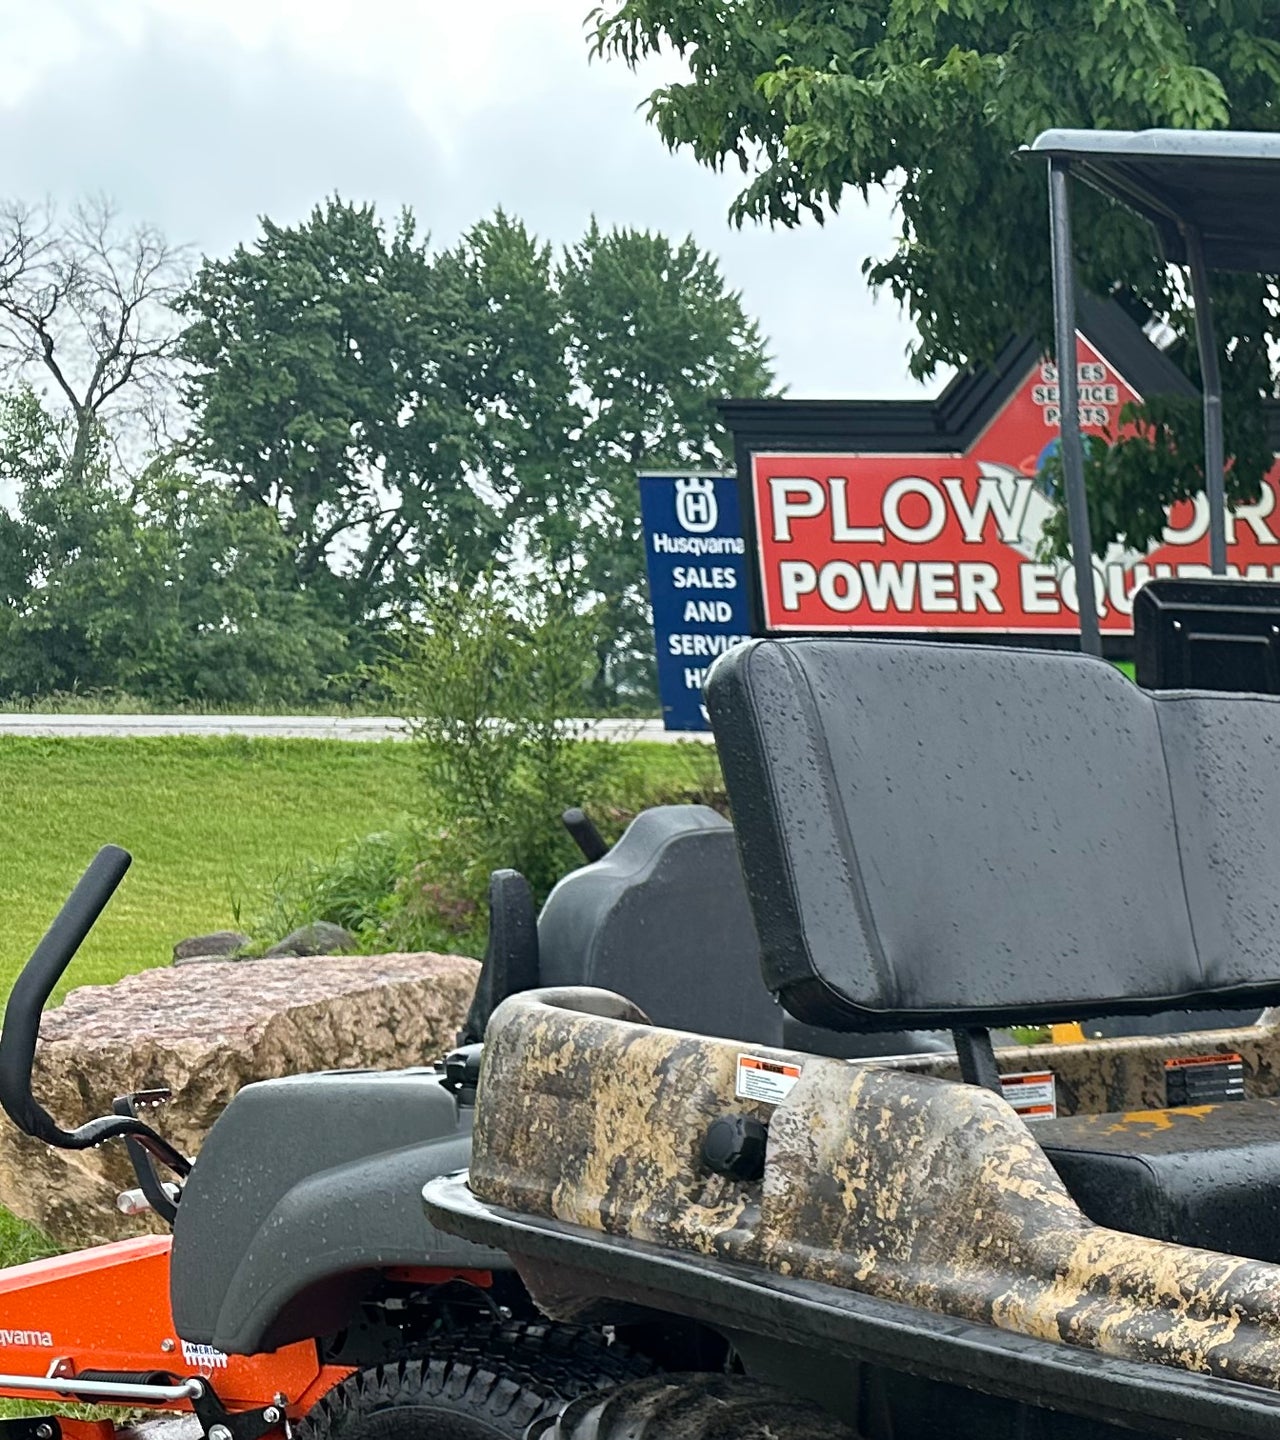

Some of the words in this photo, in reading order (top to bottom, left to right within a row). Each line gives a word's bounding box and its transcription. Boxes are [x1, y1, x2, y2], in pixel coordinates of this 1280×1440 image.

[1042, 364, 1105, 382] SES
[1034, 385, 1115, 402] SEICE
[1046, 407, 1107, 423] PTS
[768, 476, 1034, 544] PLOW
[653, 533, 745, 557] Husqvarna
[672, 566, 737, 589] SALES
[779, 560, 1004, 612] POWER
[683, 600, 733, 623] AND
